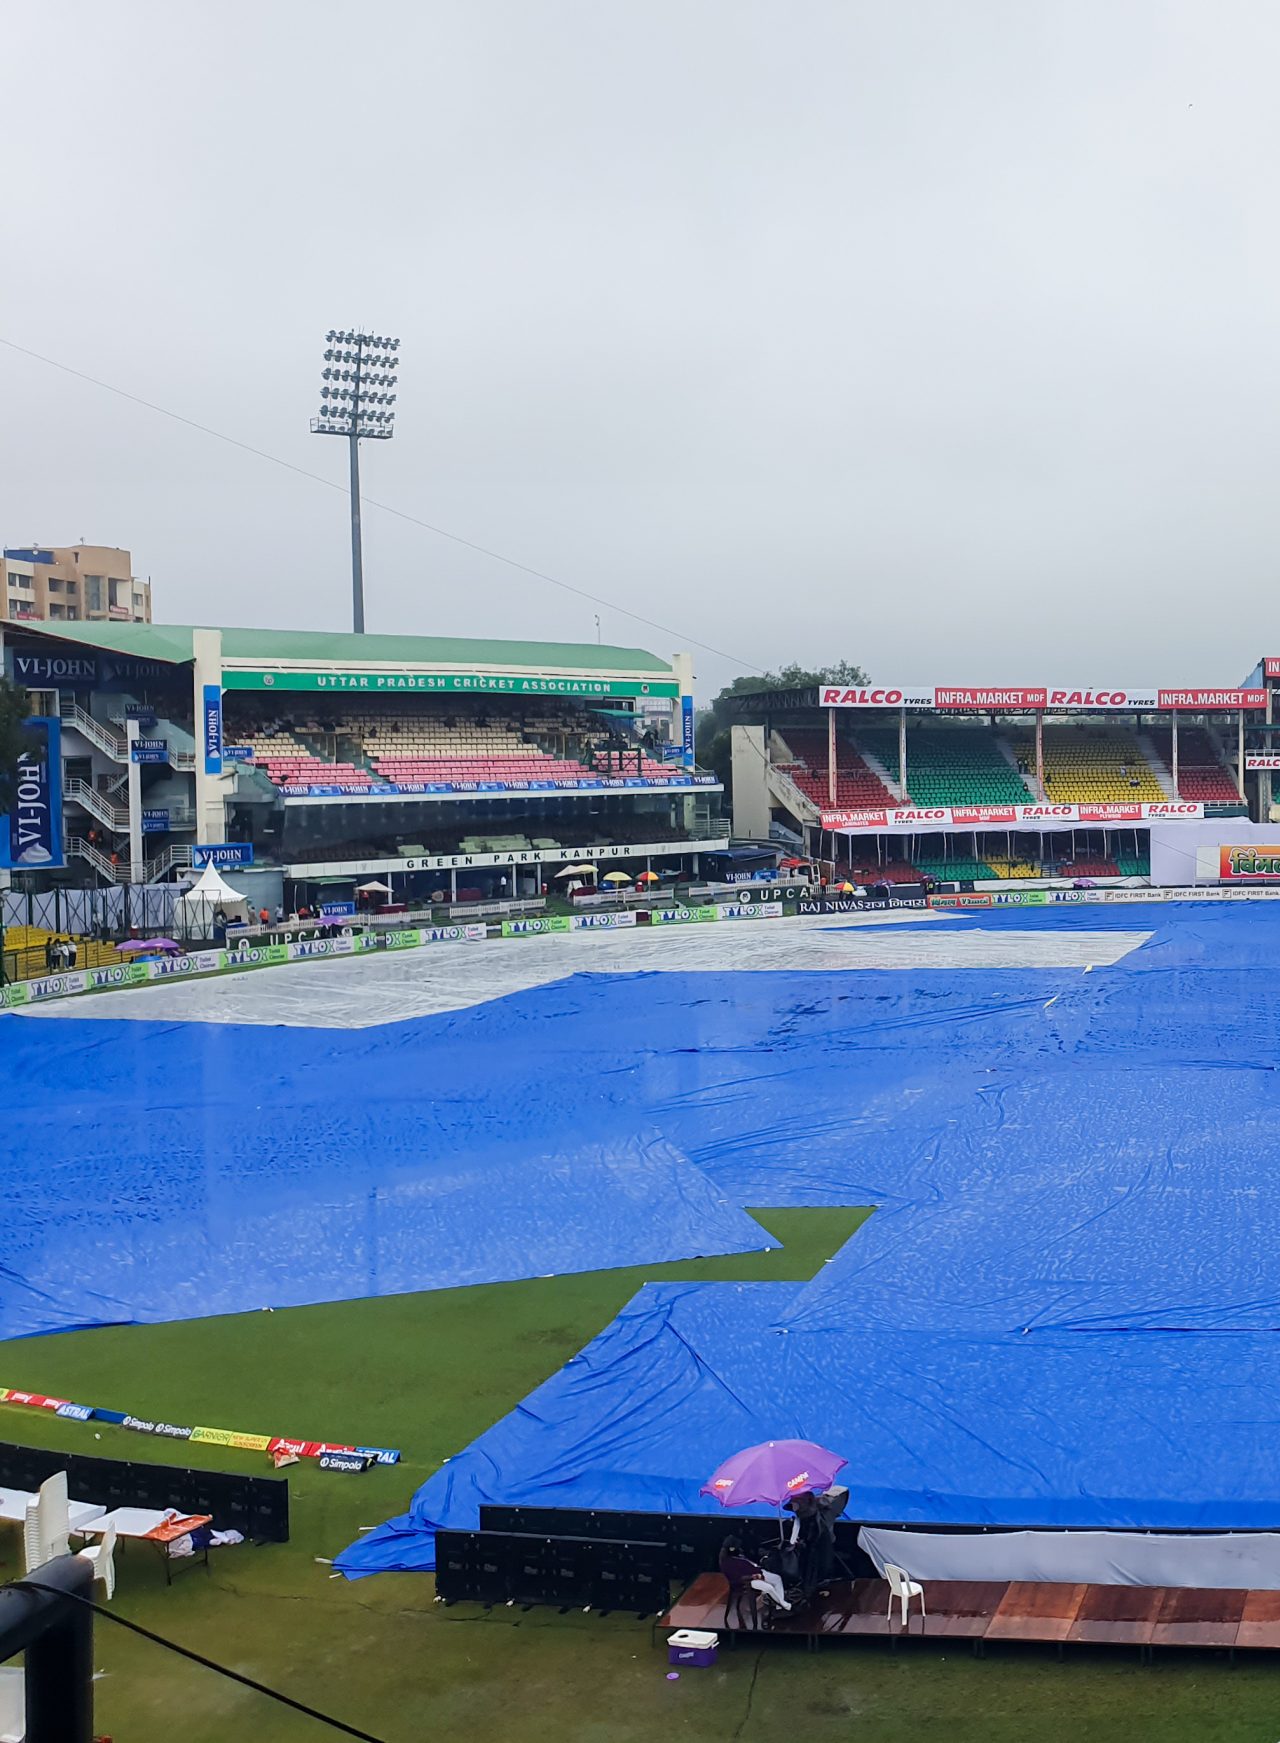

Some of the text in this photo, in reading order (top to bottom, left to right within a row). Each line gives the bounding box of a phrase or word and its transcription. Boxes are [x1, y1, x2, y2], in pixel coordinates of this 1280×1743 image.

[16, 657, 96, 678] VI-JOHN
[318, 677, 611, 692] UTTAR PRADESH CRICKET ASSOCIATION
[824, 690, 902, 703] RALCO
[938, 692, 1044, 704] INFRA.MARKET MDF
[1050, 692, 1127, 706] RALCO
[1160, 692, 1264, 705] INFRA.MARKET MDF
[208, 709, 218, 752] VI-JOHN
[134, 740, 164, 749] VI-JOHN
[278, 786, 308, 794] VI-JOHN
[340, 785, 369, 794] VI-JOHN
[399, 784, 424, 792] VI-JOHN
[452, 782, 477, 790] VI-JOHN
[504, 781, 529, 789] VI-JOHN
[554, 780, 578, 788] VI-JOHN
[895, 810, 944, 819] RALCO
[953, 808, 1013, 817] INFRA.MARKET
[1023, 807, 1072, 815] RALCO
[1080, 805, 1140, 814] INFRA.MARKET
[822, 811, 885, 822] INFRA.MARKET
[202, 849, 242, 862] VI-JOHN
[407, 847, 630, 868] GREEN PARK KANPUR
[726, 872, 751, 881] VI-JOHN
[760, 887, 808, 900] UPCA
[992, 894, 1028, 905] TYLOX
[1050, 892, 1086, 902] TYLOX
[723, 904, 763, 917] TYLOX
[800, 900, 864, 914] RAJ NIWAS
[864, 898, 926, 910] राज निवास
[575, 913, 616, 928] TYLOX
[658, 908, 700, 922] TYLOX
[508, 918, 550, 932] TYLOX
[270, 929, 320, 946] UPCA
[426, 926, 466, 942] TYLOX
[293, 940, 336, 956] TYLOX
[224, 948, 268, 964] TYLOX
[155, 957, 198, 973] TYLOX
[91, 966, 130, 984] TYLOX
[31, 977, 68, 996] TYLOX
[60, 1405, 90, 1419] ASTRAL
[130, 1418, 155, 1431] Simpolo
[164, 1424, 192, 1436] Simpolo
[194, 1430, 228, 1441] GARNIER
[329, 1459, 362, 1470] Simpolo
